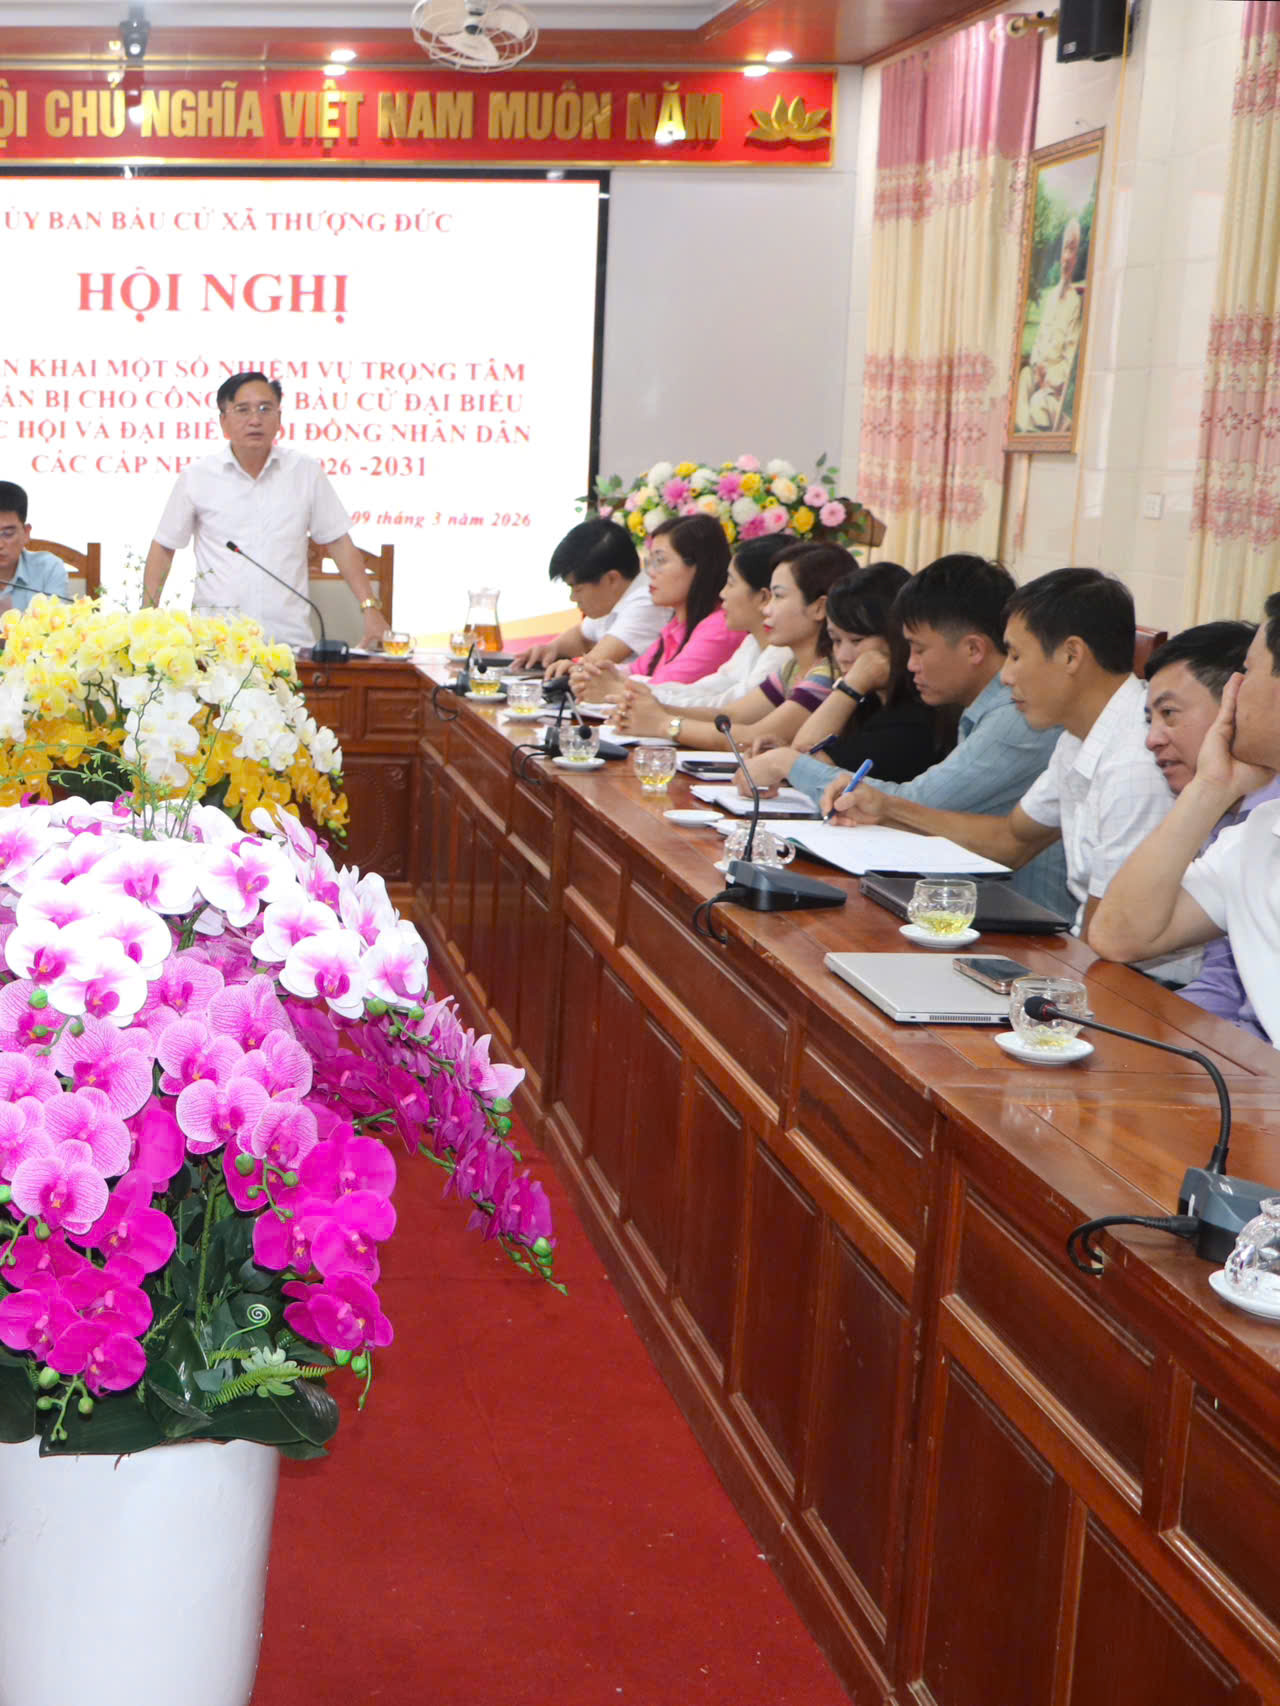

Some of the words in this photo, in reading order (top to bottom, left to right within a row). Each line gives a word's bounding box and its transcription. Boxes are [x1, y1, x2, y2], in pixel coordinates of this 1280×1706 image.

[45, 70, 126, 138] CHỦ
[140, 80, 264, 138] NGHĨA
[279, 79, 363, 149] VIỆT
[377, 91, 473, 139] NAM
[488, 80, 612, 140] MUÔN
[625, 80, 722, 142] NĂM
[48, 211, 102, 231] BAN
[222, 207, 257, 231] XÃ
[266, 209, 387, 237] THƯỢNG
[394, 208, 453, 232] ĐỨC
[76, 265, 183, 323] HỘI
[201, 272, 349, 325] NGHỊ
[29, 358, 97, 378] KHAI
[107, 357, 169, 383] MỘT
[317, 360, 353, 385] VỤ
[361, 360, 457, 385] TRỌNG
[465, 358, 526, 383] TÂM
[45, 389, 70, 413] BỊ
[78, 389, 138, 409] CHO
[404, 393, 451, 416] ĐẠI
[18, 418, 67, 443] HỘI
[74, 417, 111, 440] VÀ
[119, 420, 165, 445] ĐẠI
[175, 417, 219, 440] BIỂ
[391, 418, 467, 444] NHÂN
[475, 419, 531, 444] DÂN
[31, 449, 87, 473] CÁC
[376, 510, 425, 529] tháng
[432, 511, 442, 526] 3
[447, 512, 485, 527] năm
[490, 512, 532, 527] 2026
